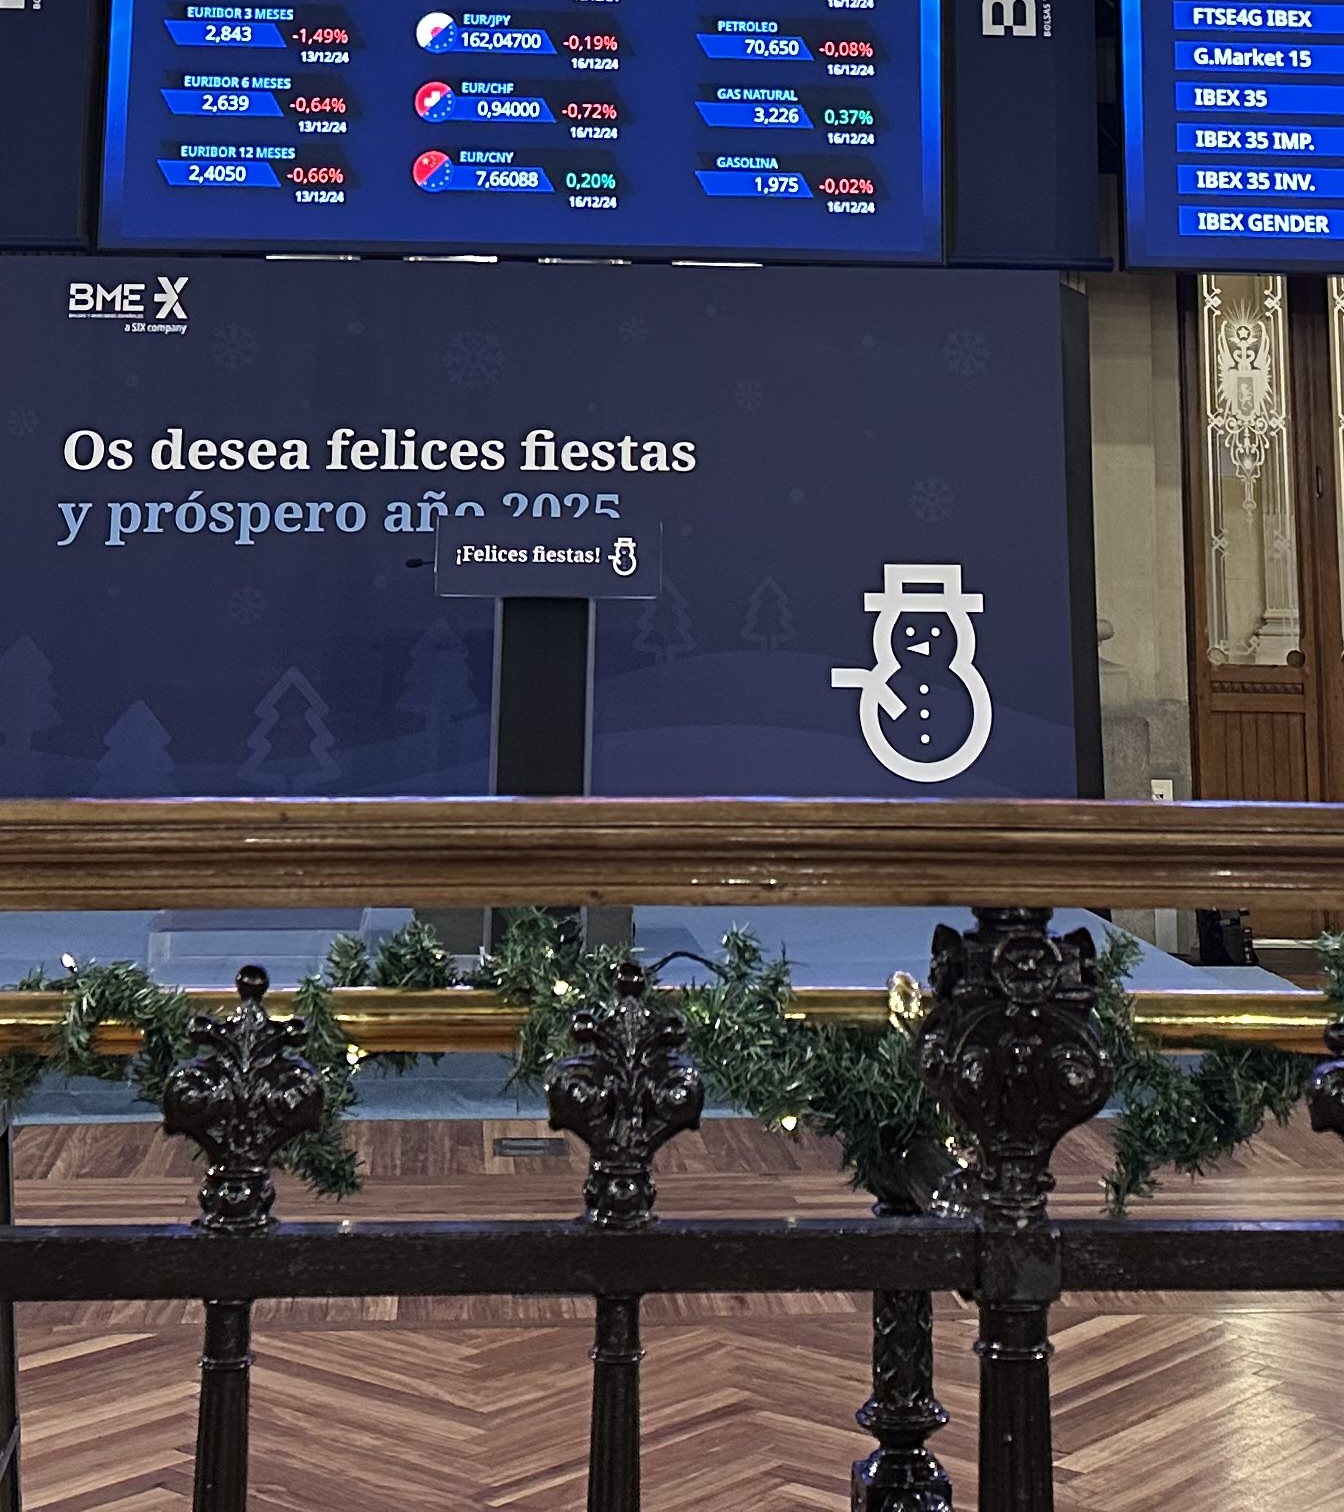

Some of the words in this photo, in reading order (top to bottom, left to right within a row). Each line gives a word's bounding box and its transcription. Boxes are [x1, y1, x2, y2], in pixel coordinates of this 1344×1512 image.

[1194, 8, 1262, 26] FTSE4G
[1266, 10, 1312, 27] IBEX
[181, 146, 236, 157] EURIBOR
[239, 147, 253, 158] 12
[256, 147, 295, 159] MESES
[189, 165, 246, 183] 2,4050
[287, 168, 343, 184] -0,66%
[1198, 213, 1244, 231] IBEX
[1248, 214, 1329, 233] GENDER
[69, 283, 145, 311] BME
[64, 430, 132, 470] Os
[151, 429, 310, 470] desea
[326, 429, 504, 470] felices
[520, 430, 695, 471] fiestas
[57, 503, 92, 545] y
[105, 491, 366, 545] próspero
[457, 545, 527, 564] ¡Felices
[532, 546, 600, 563] fiestas!
